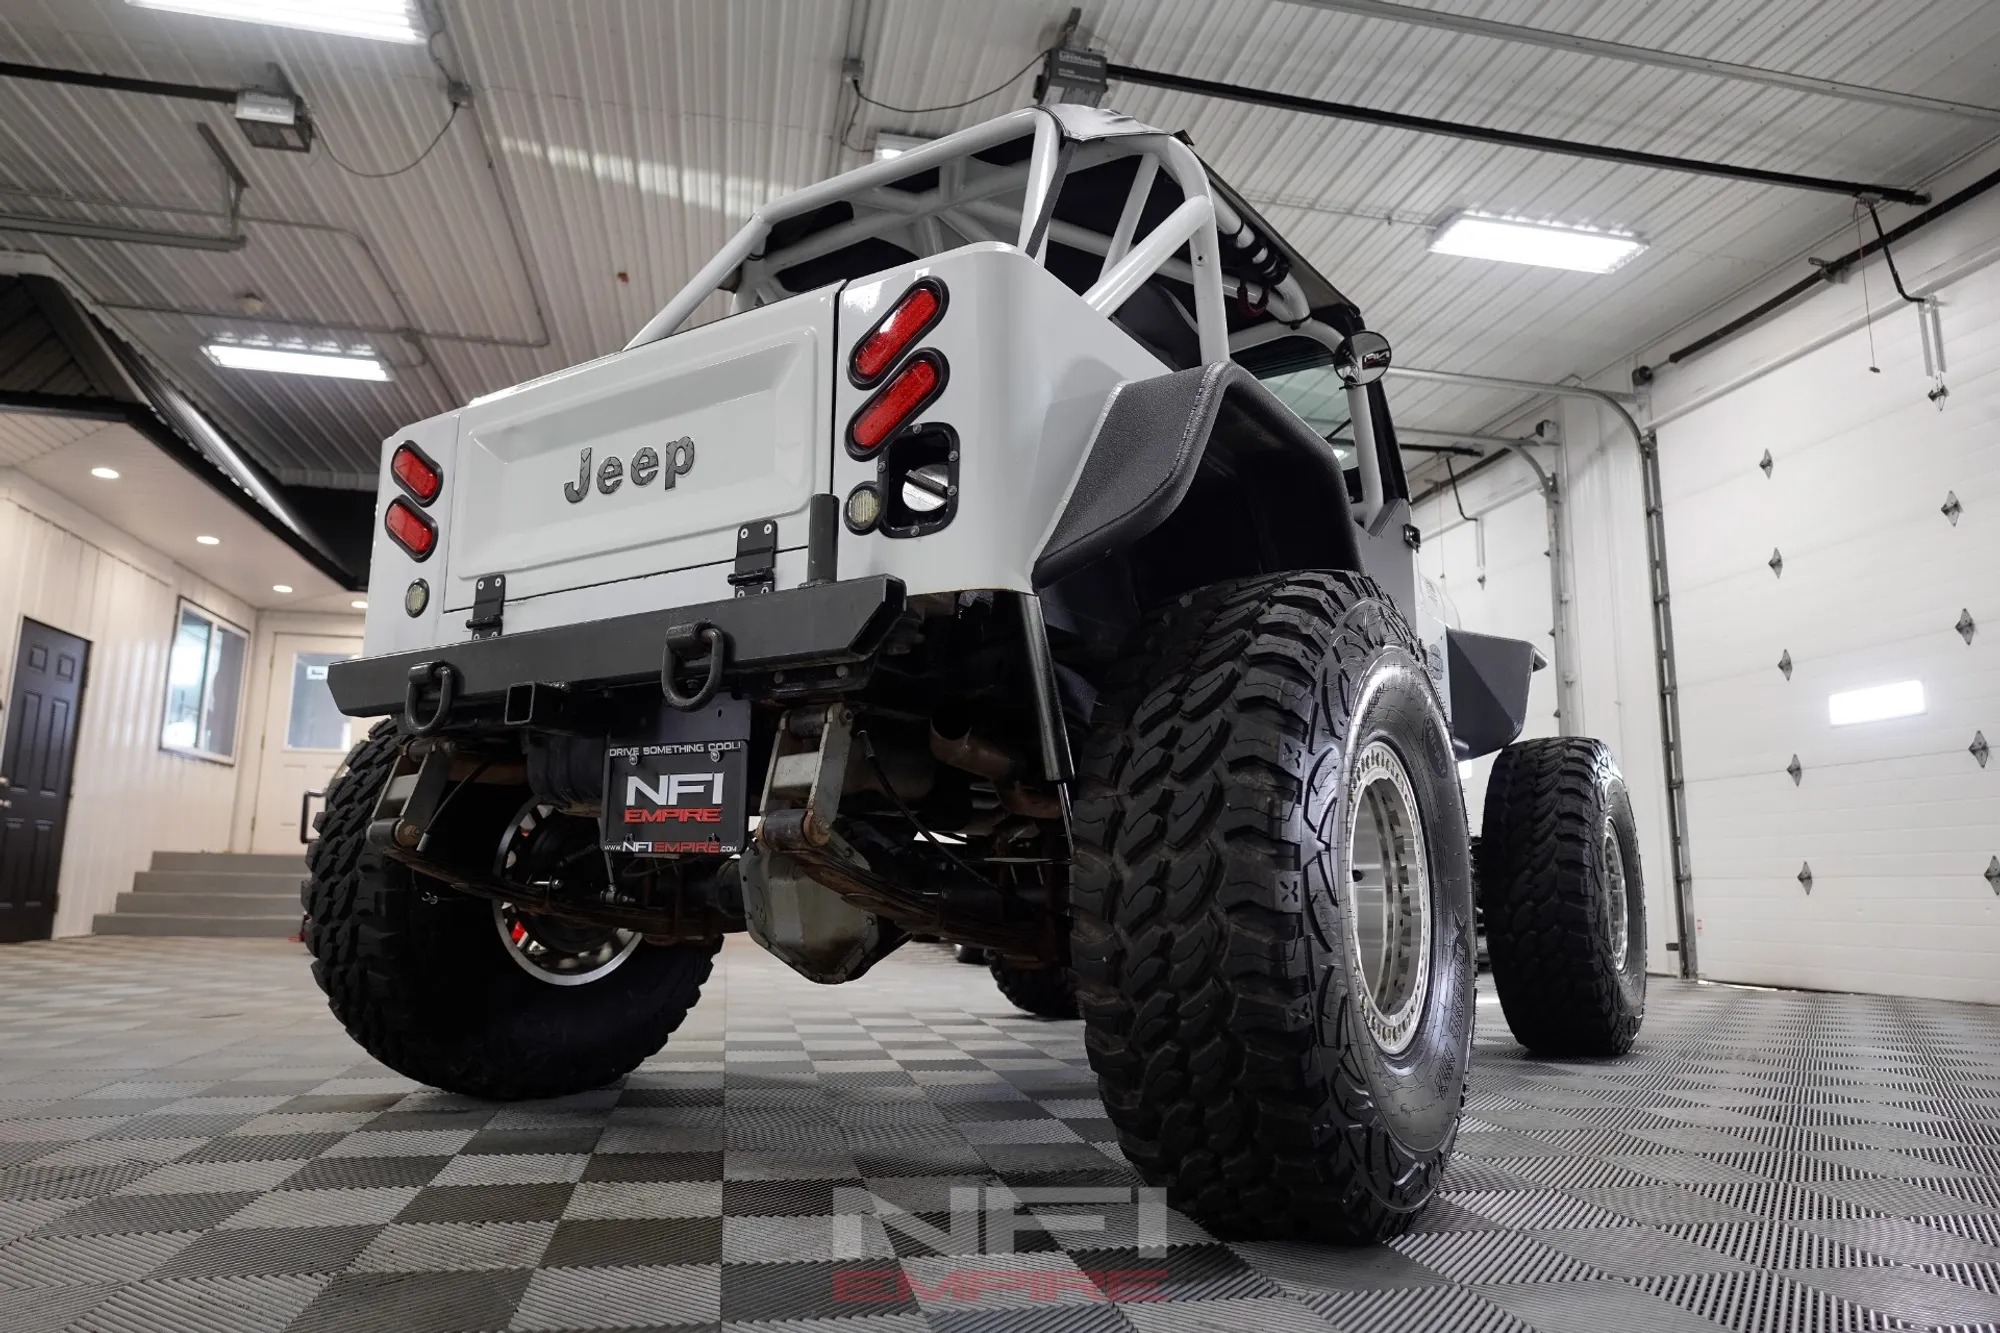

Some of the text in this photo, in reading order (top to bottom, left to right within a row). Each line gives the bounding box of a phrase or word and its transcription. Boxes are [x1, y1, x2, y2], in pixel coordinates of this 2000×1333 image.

[563, 435, 695, 504] Jeep
[609, 747, 640, 757] DRIVE
[642, 744, 705, 755] SOMETHING
[625, 772, 725, 806] NFI
[624, 808, 723, 823] EMPIRE
